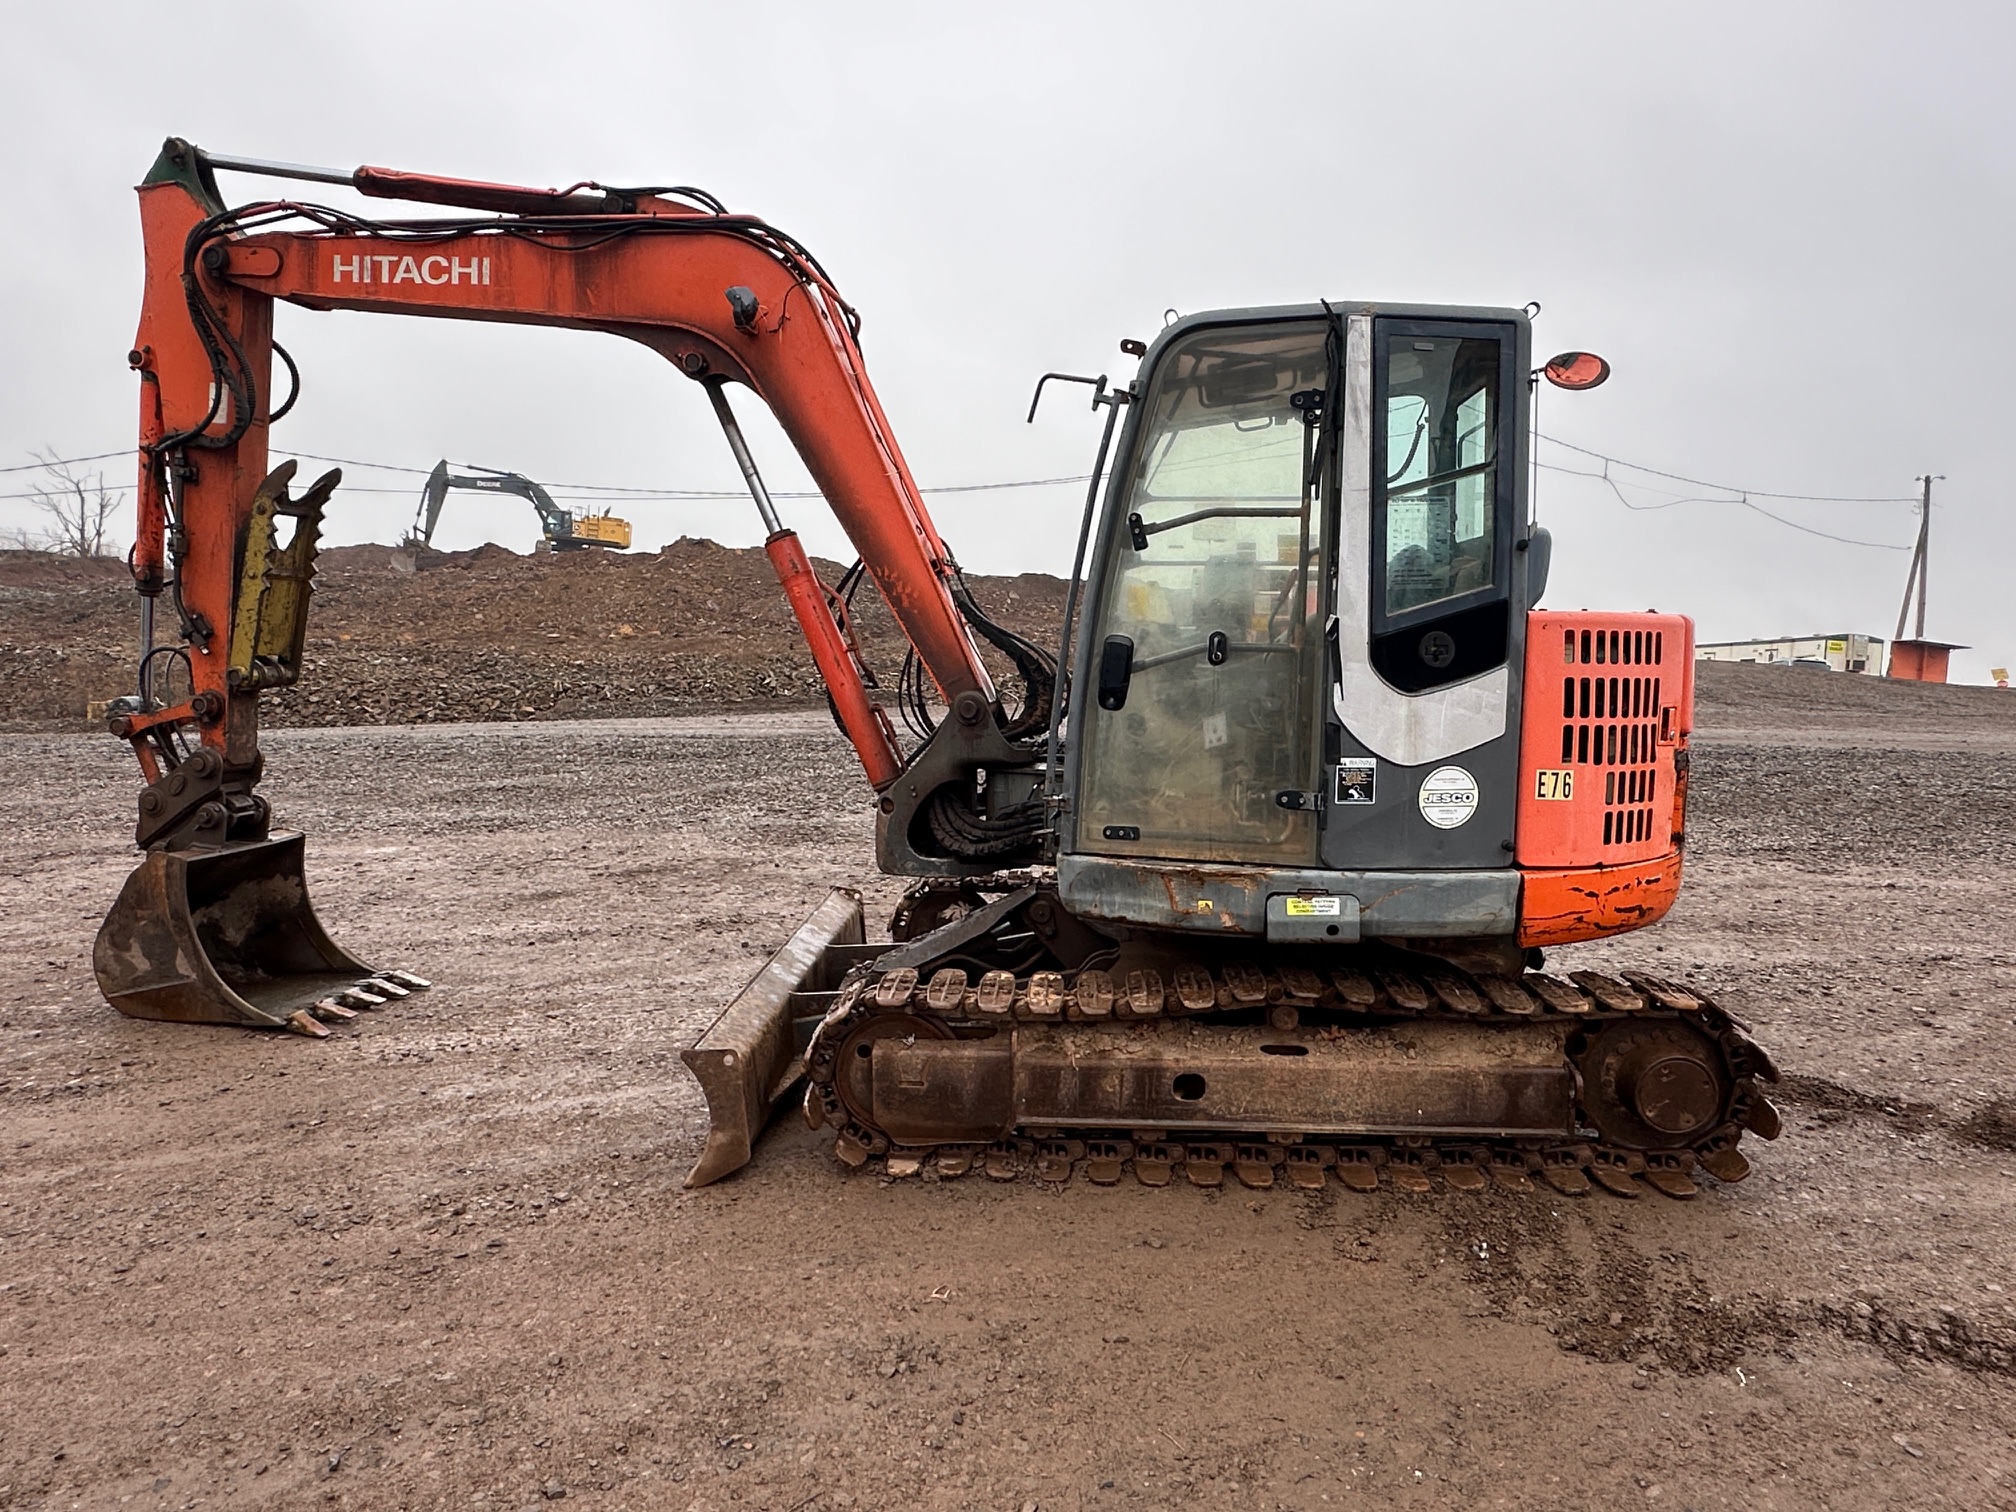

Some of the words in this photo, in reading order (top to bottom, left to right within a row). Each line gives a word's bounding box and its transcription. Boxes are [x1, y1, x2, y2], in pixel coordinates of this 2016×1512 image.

[333, 254, 491, 286] HITACHI
[1423, 792, 1475, 804] JESCO
[1537, 771, 1572, 799] E76
